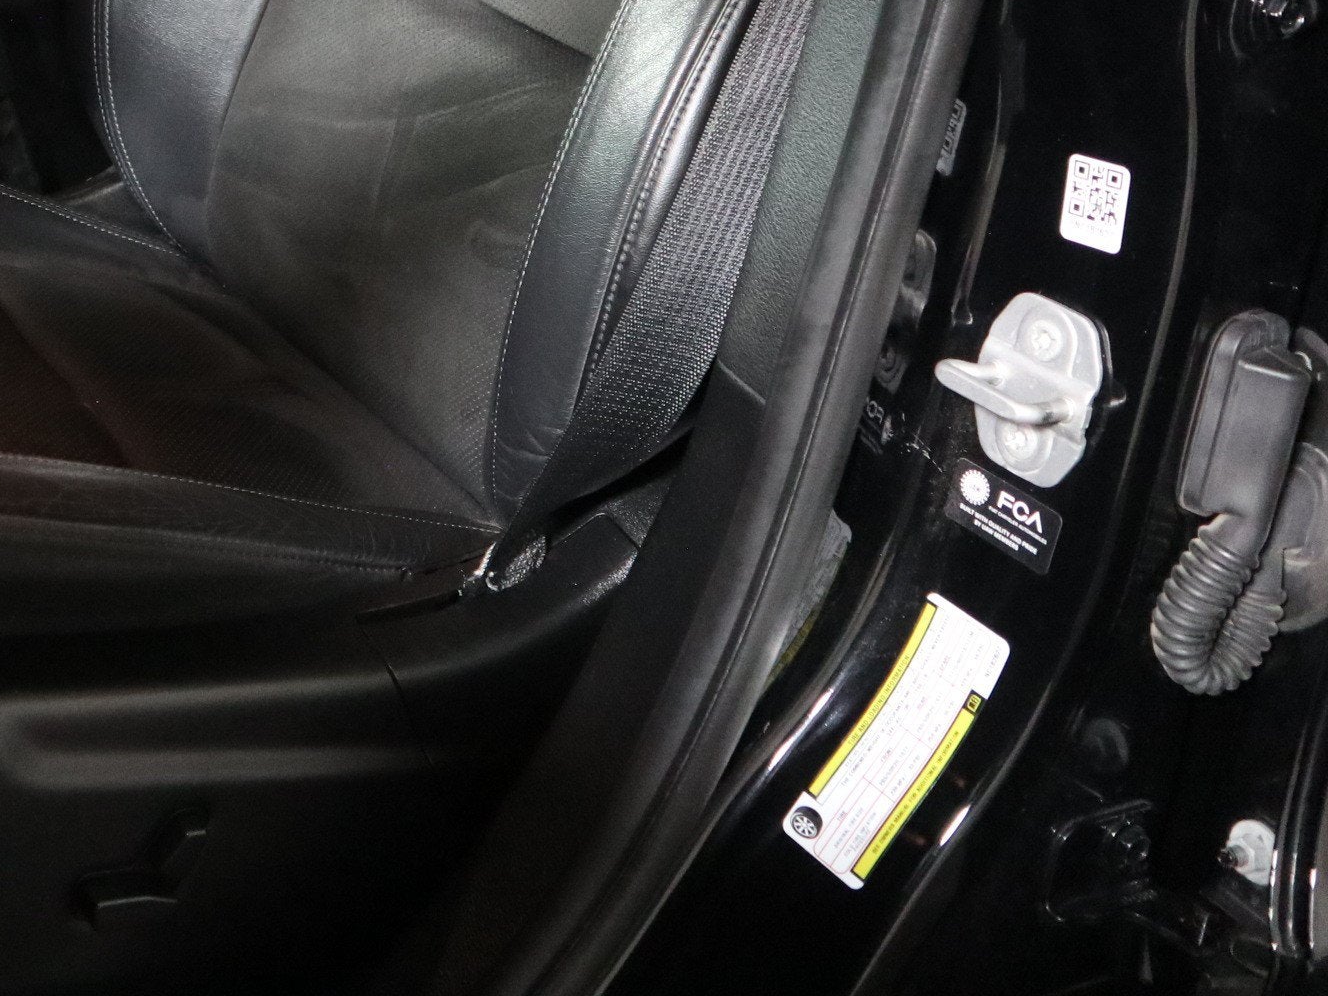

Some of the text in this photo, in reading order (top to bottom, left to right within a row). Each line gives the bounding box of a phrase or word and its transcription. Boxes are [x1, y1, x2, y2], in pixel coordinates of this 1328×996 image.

[988, 520, 1010, 536] QUALITY
[996, 490, 1043, 534] FCA
[857, 719, 868, 731] AND
[865, 694, 886, 721] LOADING
[883, 654, 910, 694] INFORMATION
